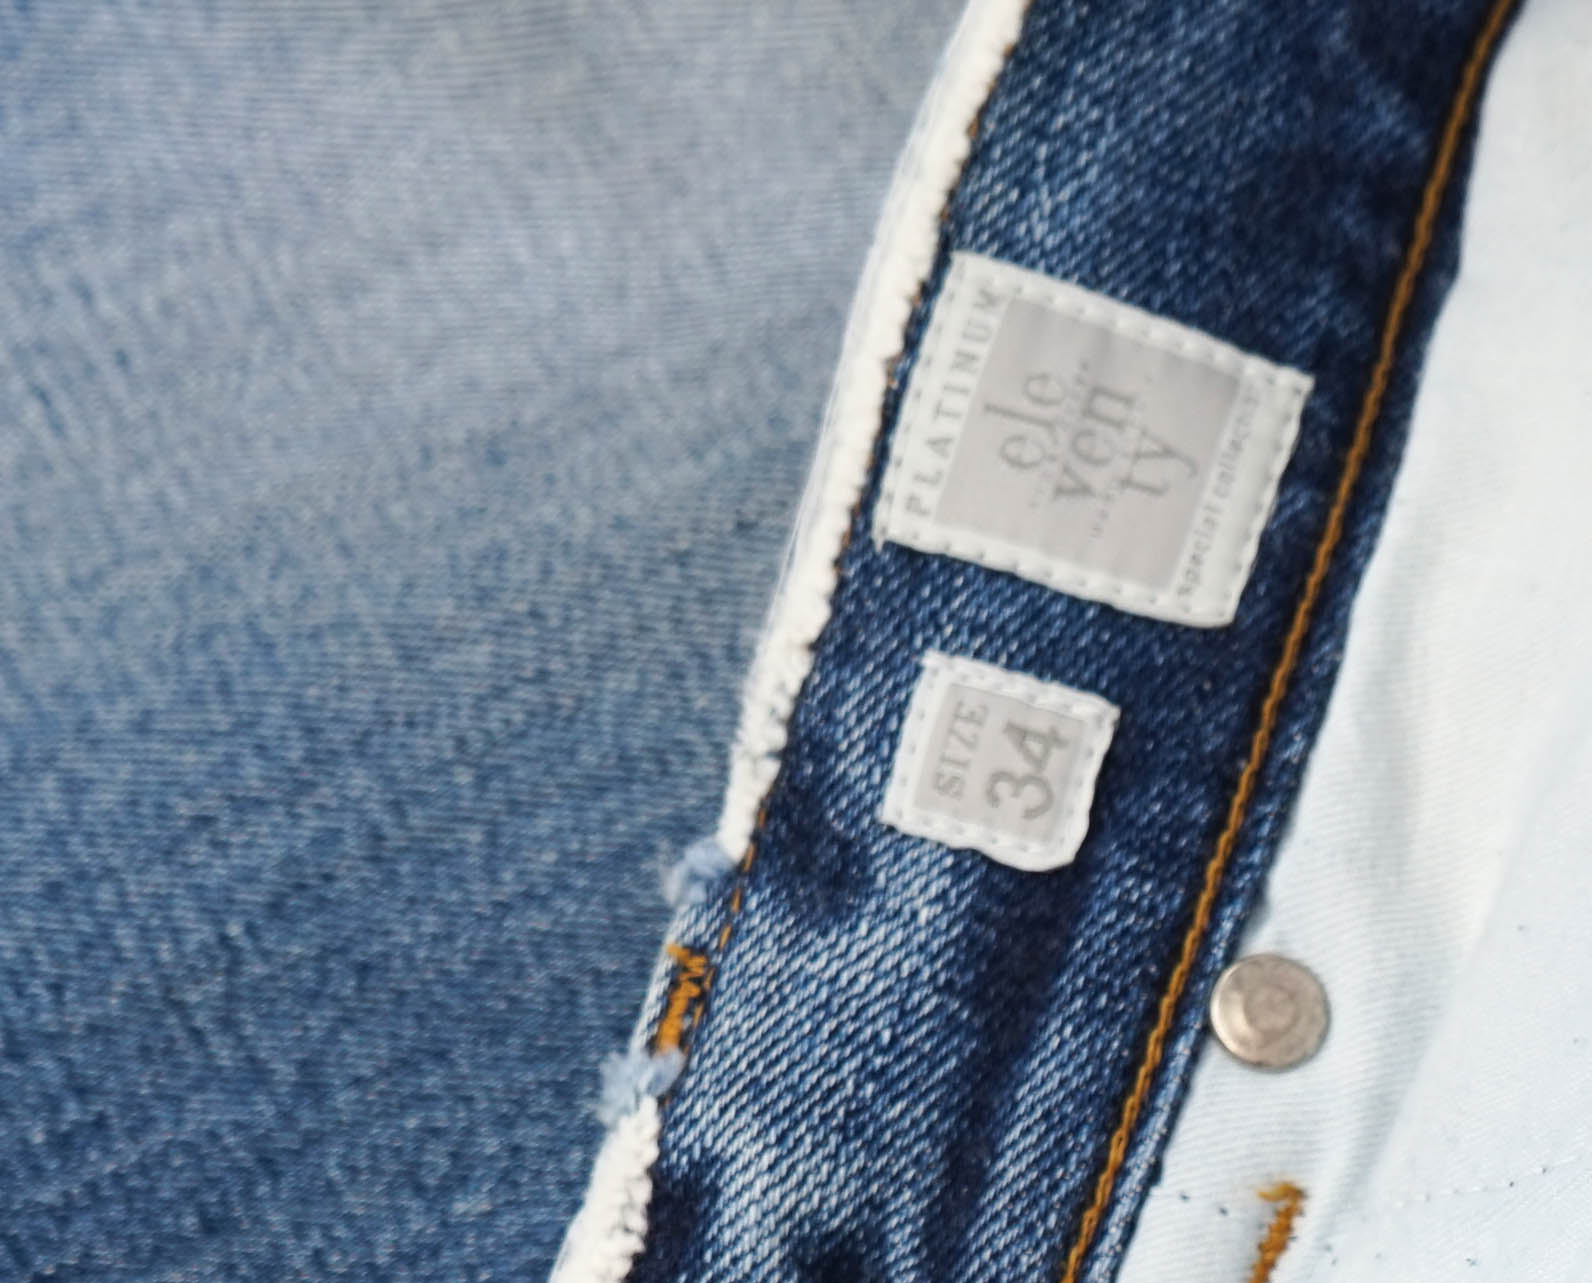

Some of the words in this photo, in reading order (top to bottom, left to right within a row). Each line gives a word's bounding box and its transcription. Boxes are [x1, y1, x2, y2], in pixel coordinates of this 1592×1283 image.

[904, 287, 1000, 517] PLATINUM
[934, 702, 988, 799] SIZE
[986, 718, 1069, 820] 34
